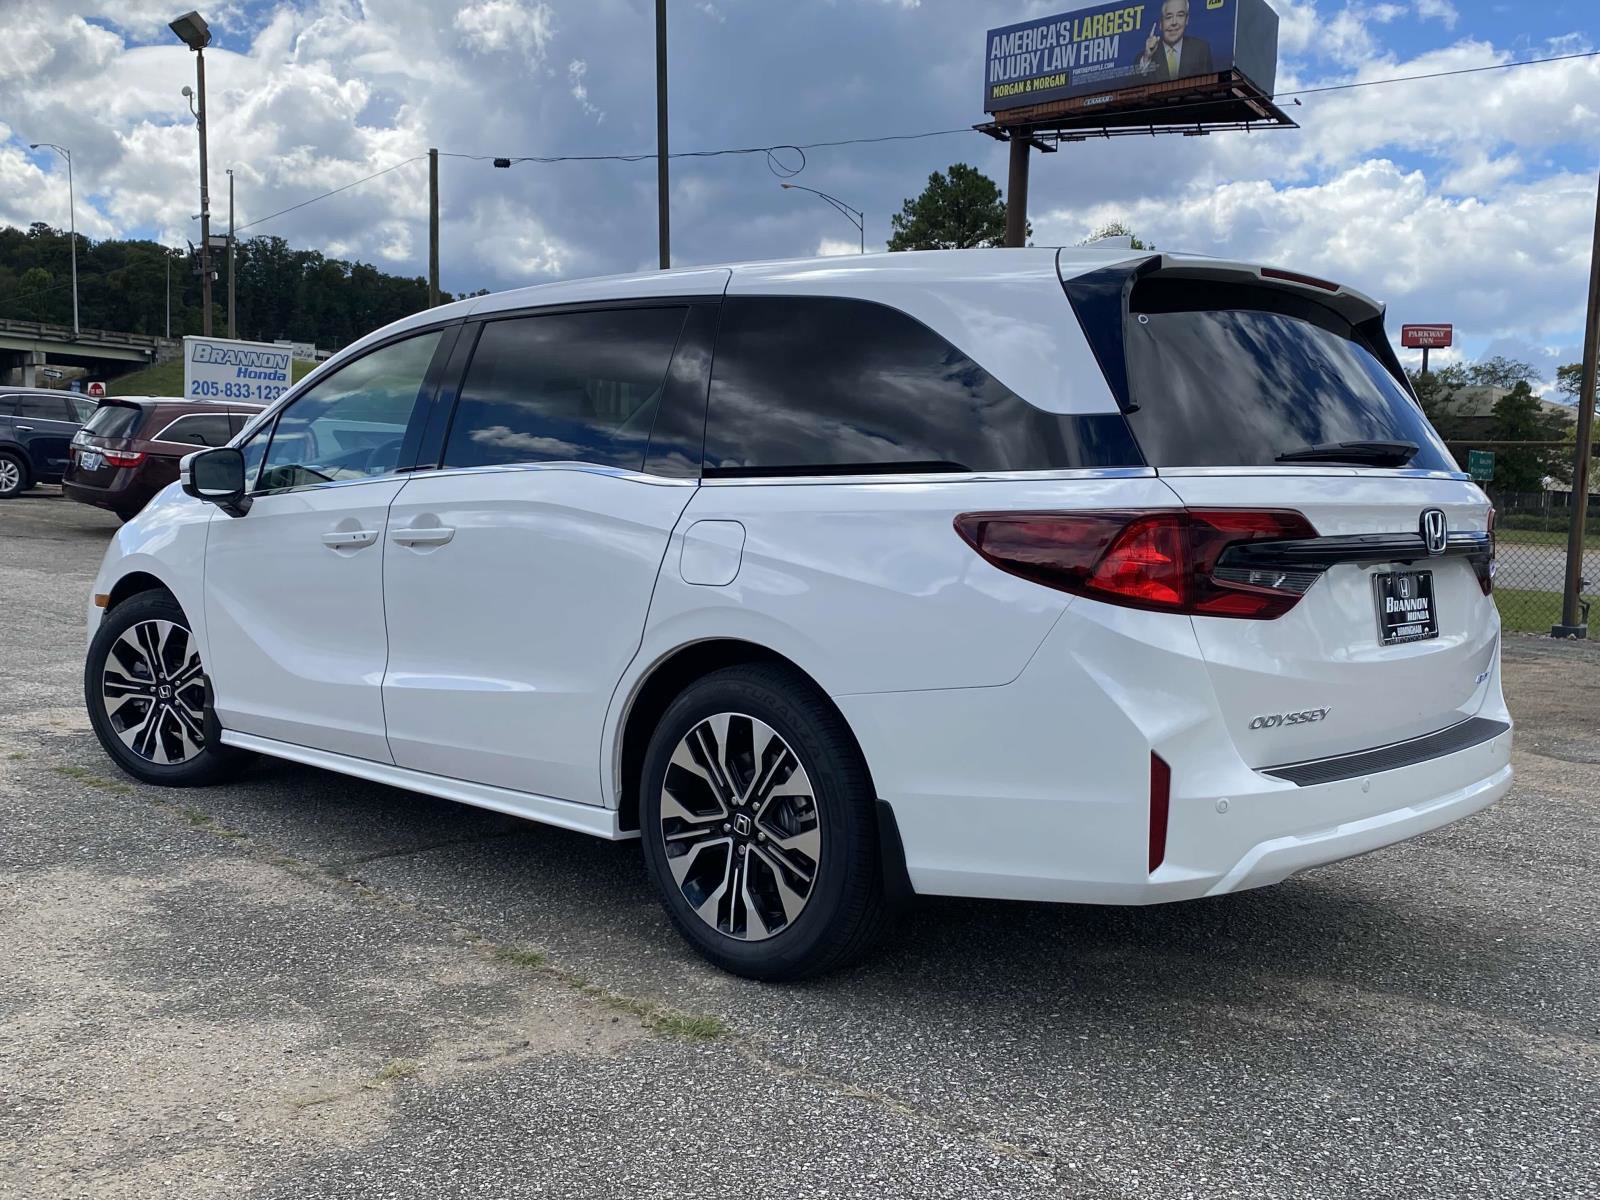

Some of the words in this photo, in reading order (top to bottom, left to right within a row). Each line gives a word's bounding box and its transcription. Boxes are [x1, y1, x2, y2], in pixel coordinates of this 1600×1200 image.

[990, 21, 1070, 60] AMERICA'S
[1073, 5, 1145, 42] LARGEST
[989, 50, 1041, 82] INJURY
[1043, 43, 1078, 72] LAW
[1080, 34, 1120, 65] FIRM
[993, 81, 1025, 98] MORGAN
[1025, 80, 1032, 92] &
[1033, 73, 1066, 91] MORGAN
[1408, 330, 1445, 338] PARKWAY
[192, 343, 289, 370] BRANNON
[236, 366, 287, 381] Honda
[1386, 597, 1428, 613] BRANNON
[1248, 706, 1332, 730] ODYSSEY
